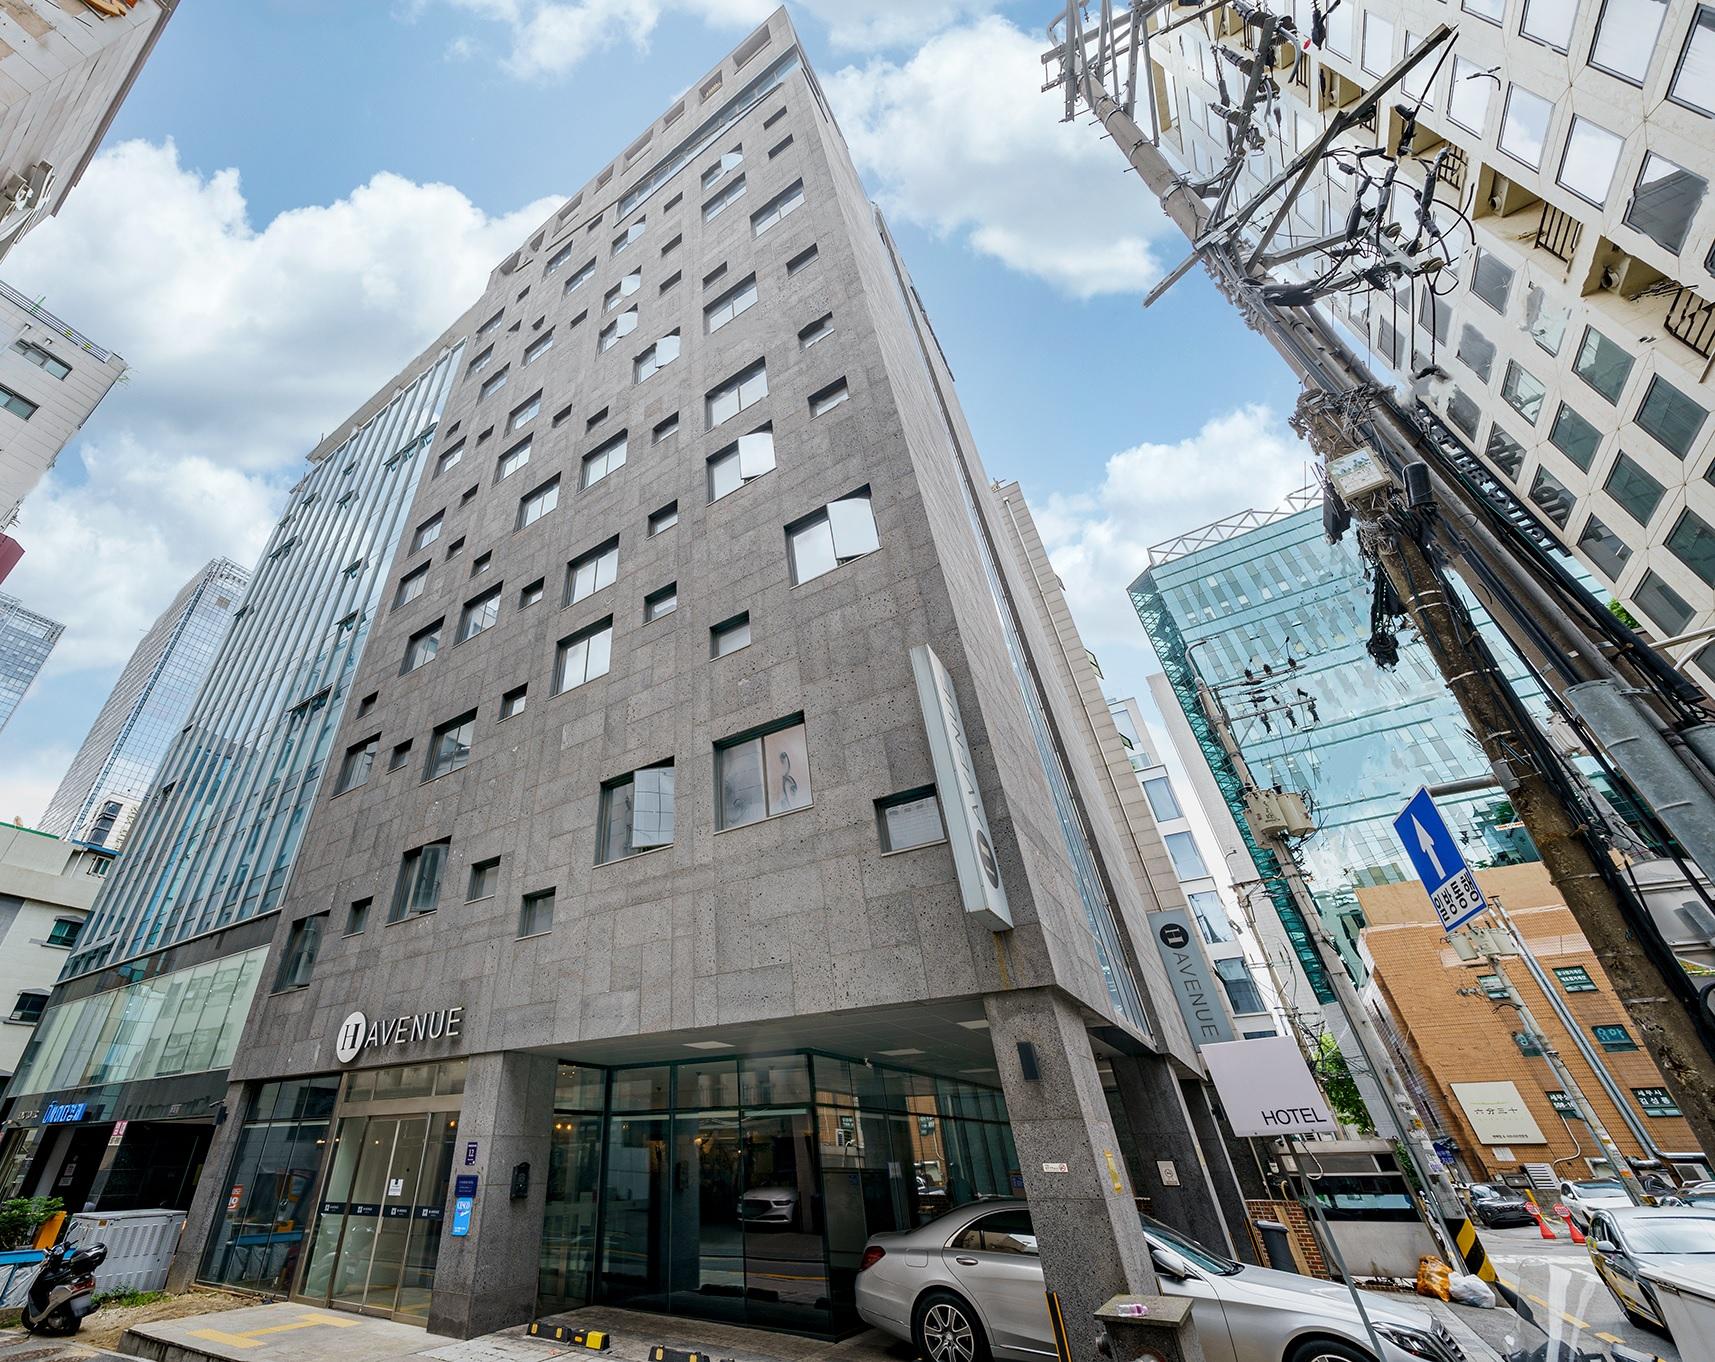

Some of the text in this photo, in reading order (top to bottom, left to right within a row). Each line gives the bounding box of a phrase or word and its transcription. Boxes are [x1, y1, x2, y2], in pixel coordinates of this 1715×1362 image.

[1433, 871, 1479, 922] 일방통행
[1172, 951, 1220, 1038] AVENUE
[364, 1006, 464, 1049] AVENUE
[1261, 1107, 1327, 1126] HOTEL
